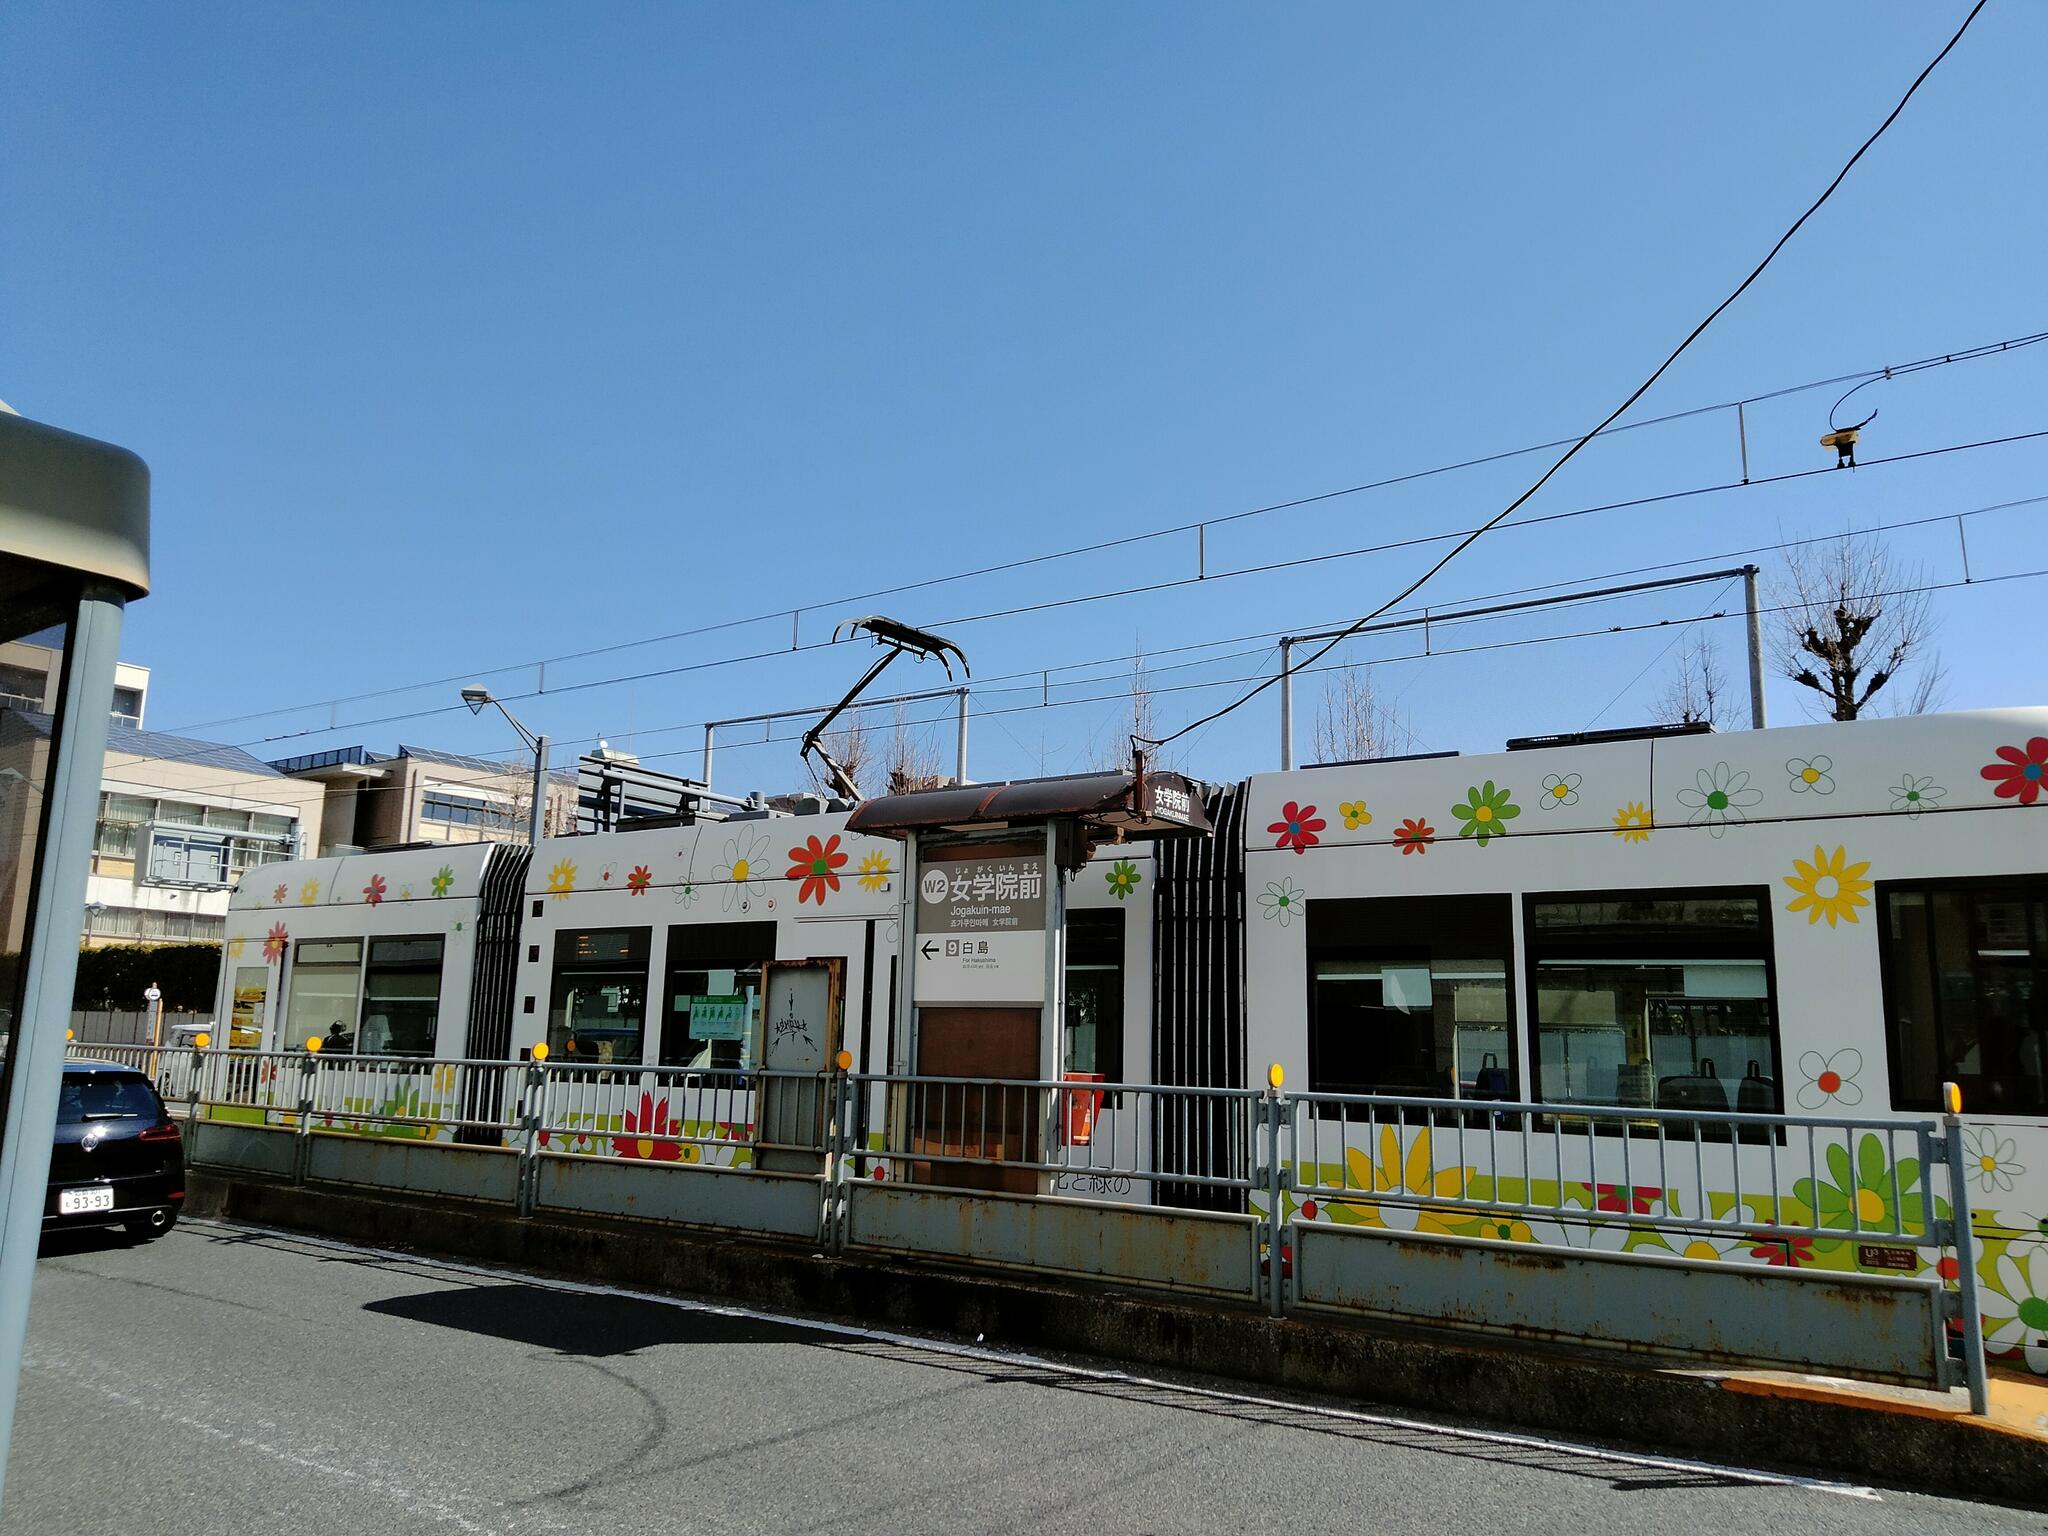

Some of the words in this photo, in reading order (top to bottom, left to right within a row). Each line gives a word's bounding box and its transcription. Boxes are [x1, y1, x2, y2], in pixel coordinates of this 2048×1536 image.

[1154, 785, 1190, 813] 女学院前
[977, 865, 993, 873] がく
[999, 863, 1015, 872] いん
[1023, 862, 1039, 870] まえ
[924, 879, 946, 894] W2
[950, 870, 1042, 903] 女学院前
[950, 904, 1011, 917] Jogakuin-mae
[947, 941, 958, 955] 9
[962, 940, 989, 955] 白島
[73, 1194, 110, 1210] 93-93
